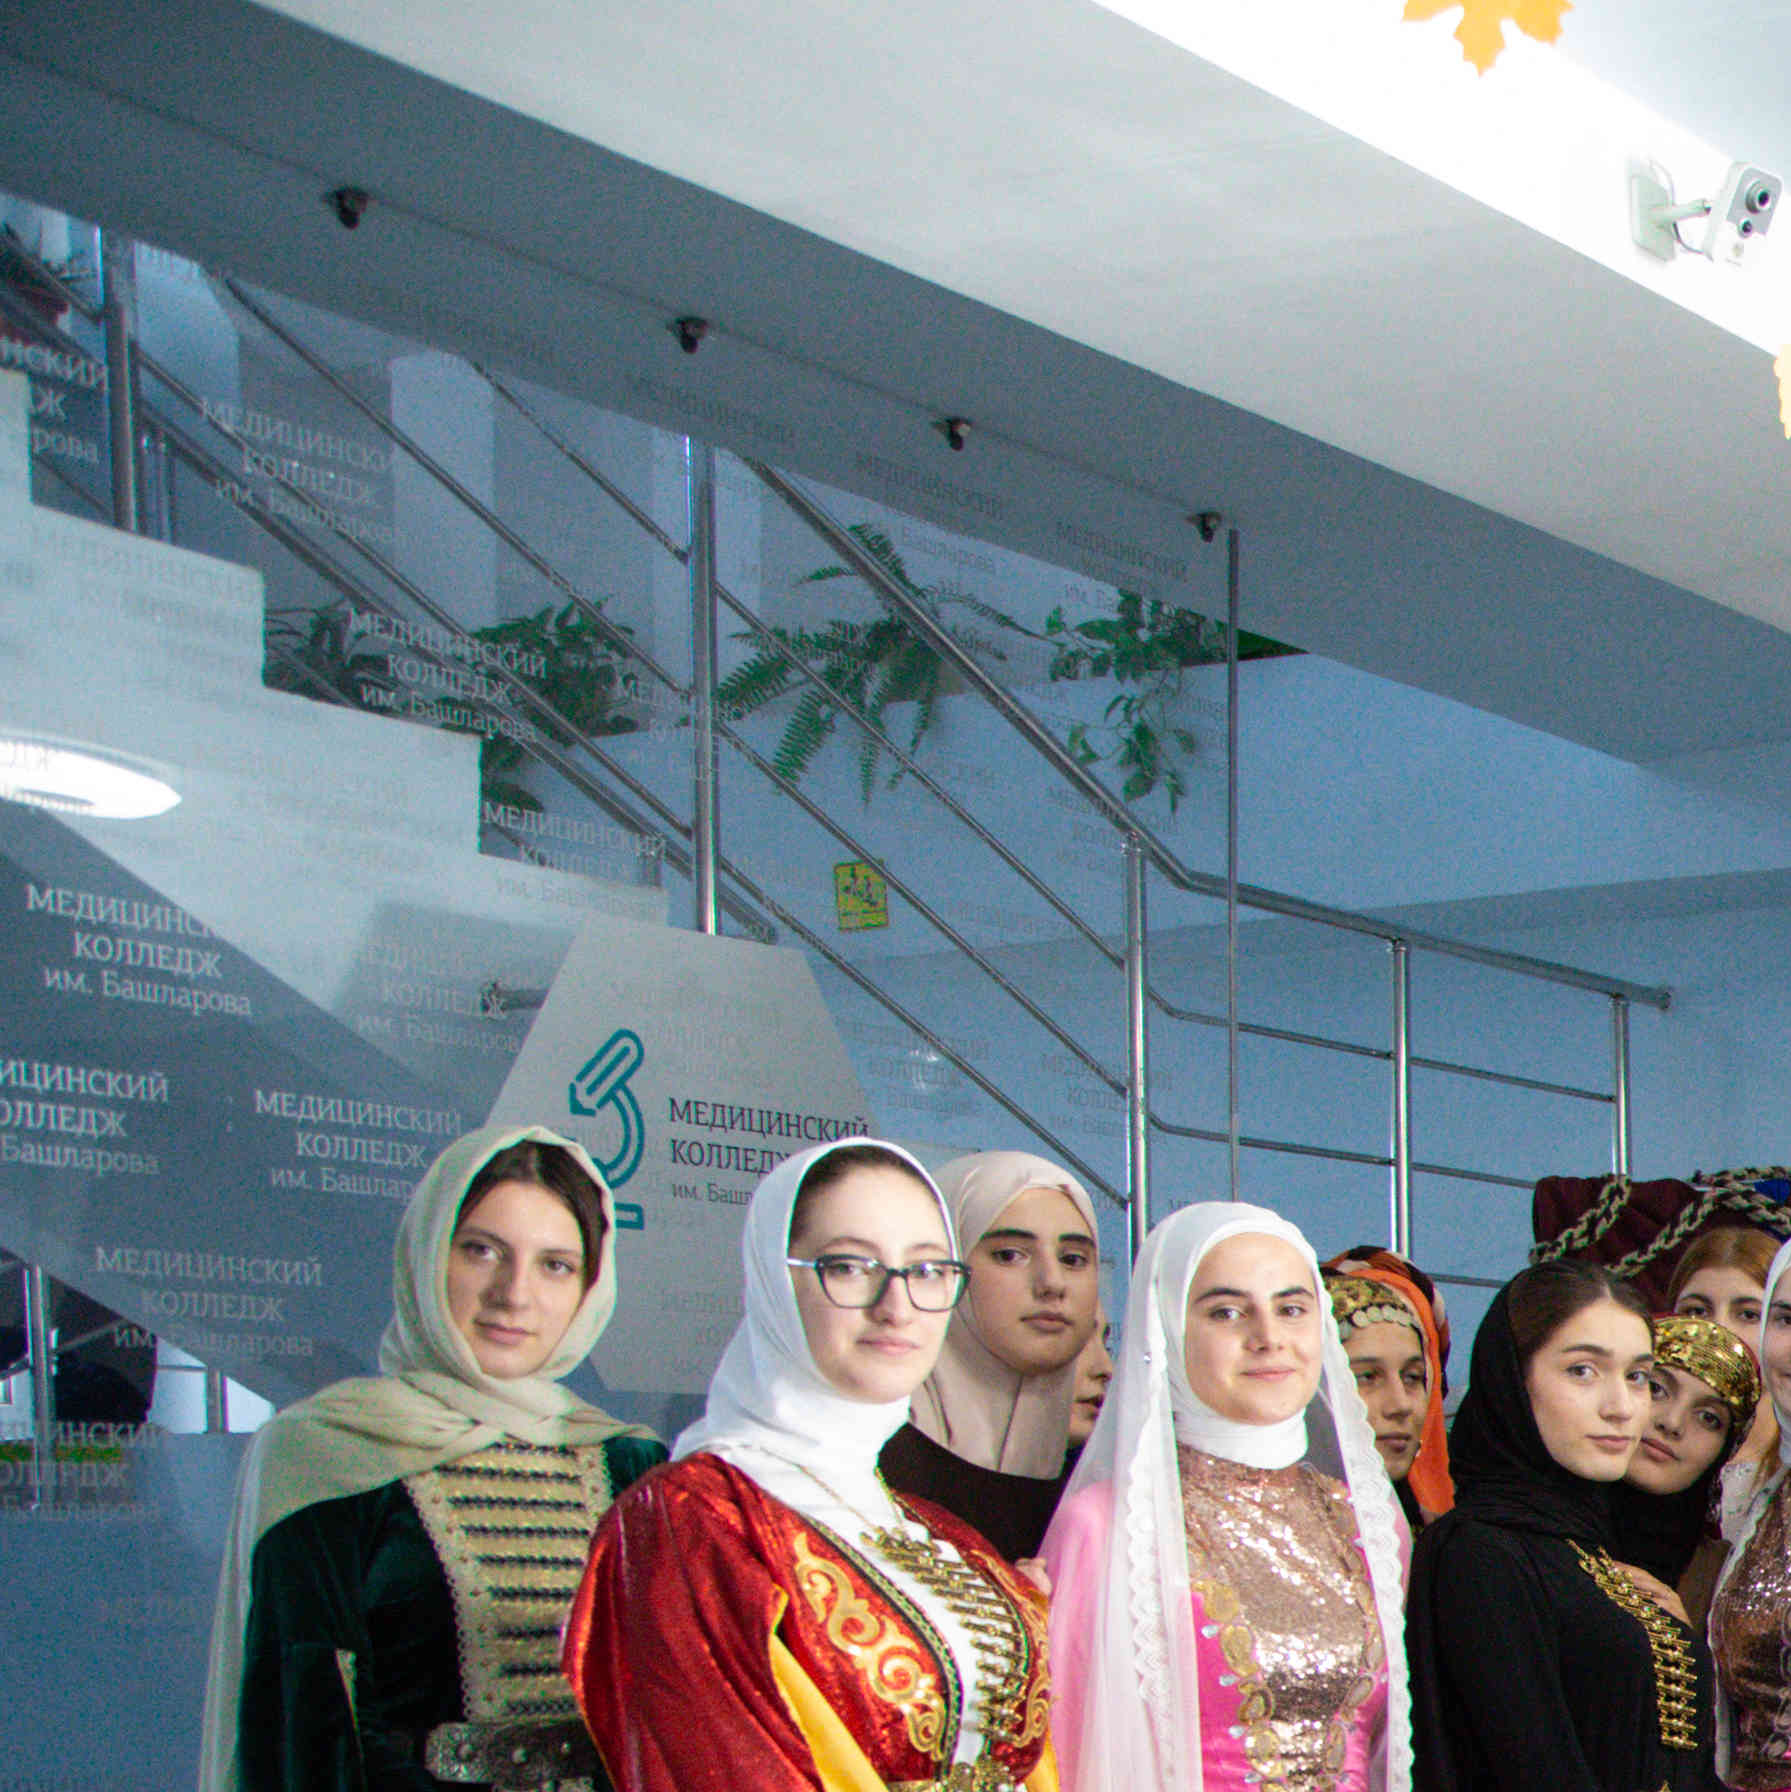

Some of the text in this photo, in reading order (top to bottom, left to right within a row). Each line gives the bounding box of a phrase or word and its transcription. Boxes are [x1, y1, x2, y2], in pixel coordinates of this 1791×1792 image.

[74, 931, 224, 979] КОЛЛЕДЖ
[44, 966, 252, 1017] им. Башларова
[255, 1088, 463, 1136] МЕДИЦИНСКИЙ
[669, 1097, 869, 1142] МЕДИЦИНСКИЙ
[296, 1130, 428, 1168] КОЛЛЕДЖ
[95, 1246, 325, 1288] МЕДИЦИНСКИЙ
[142, 1289, 286, 1321] КОЛЛЕДЖ
